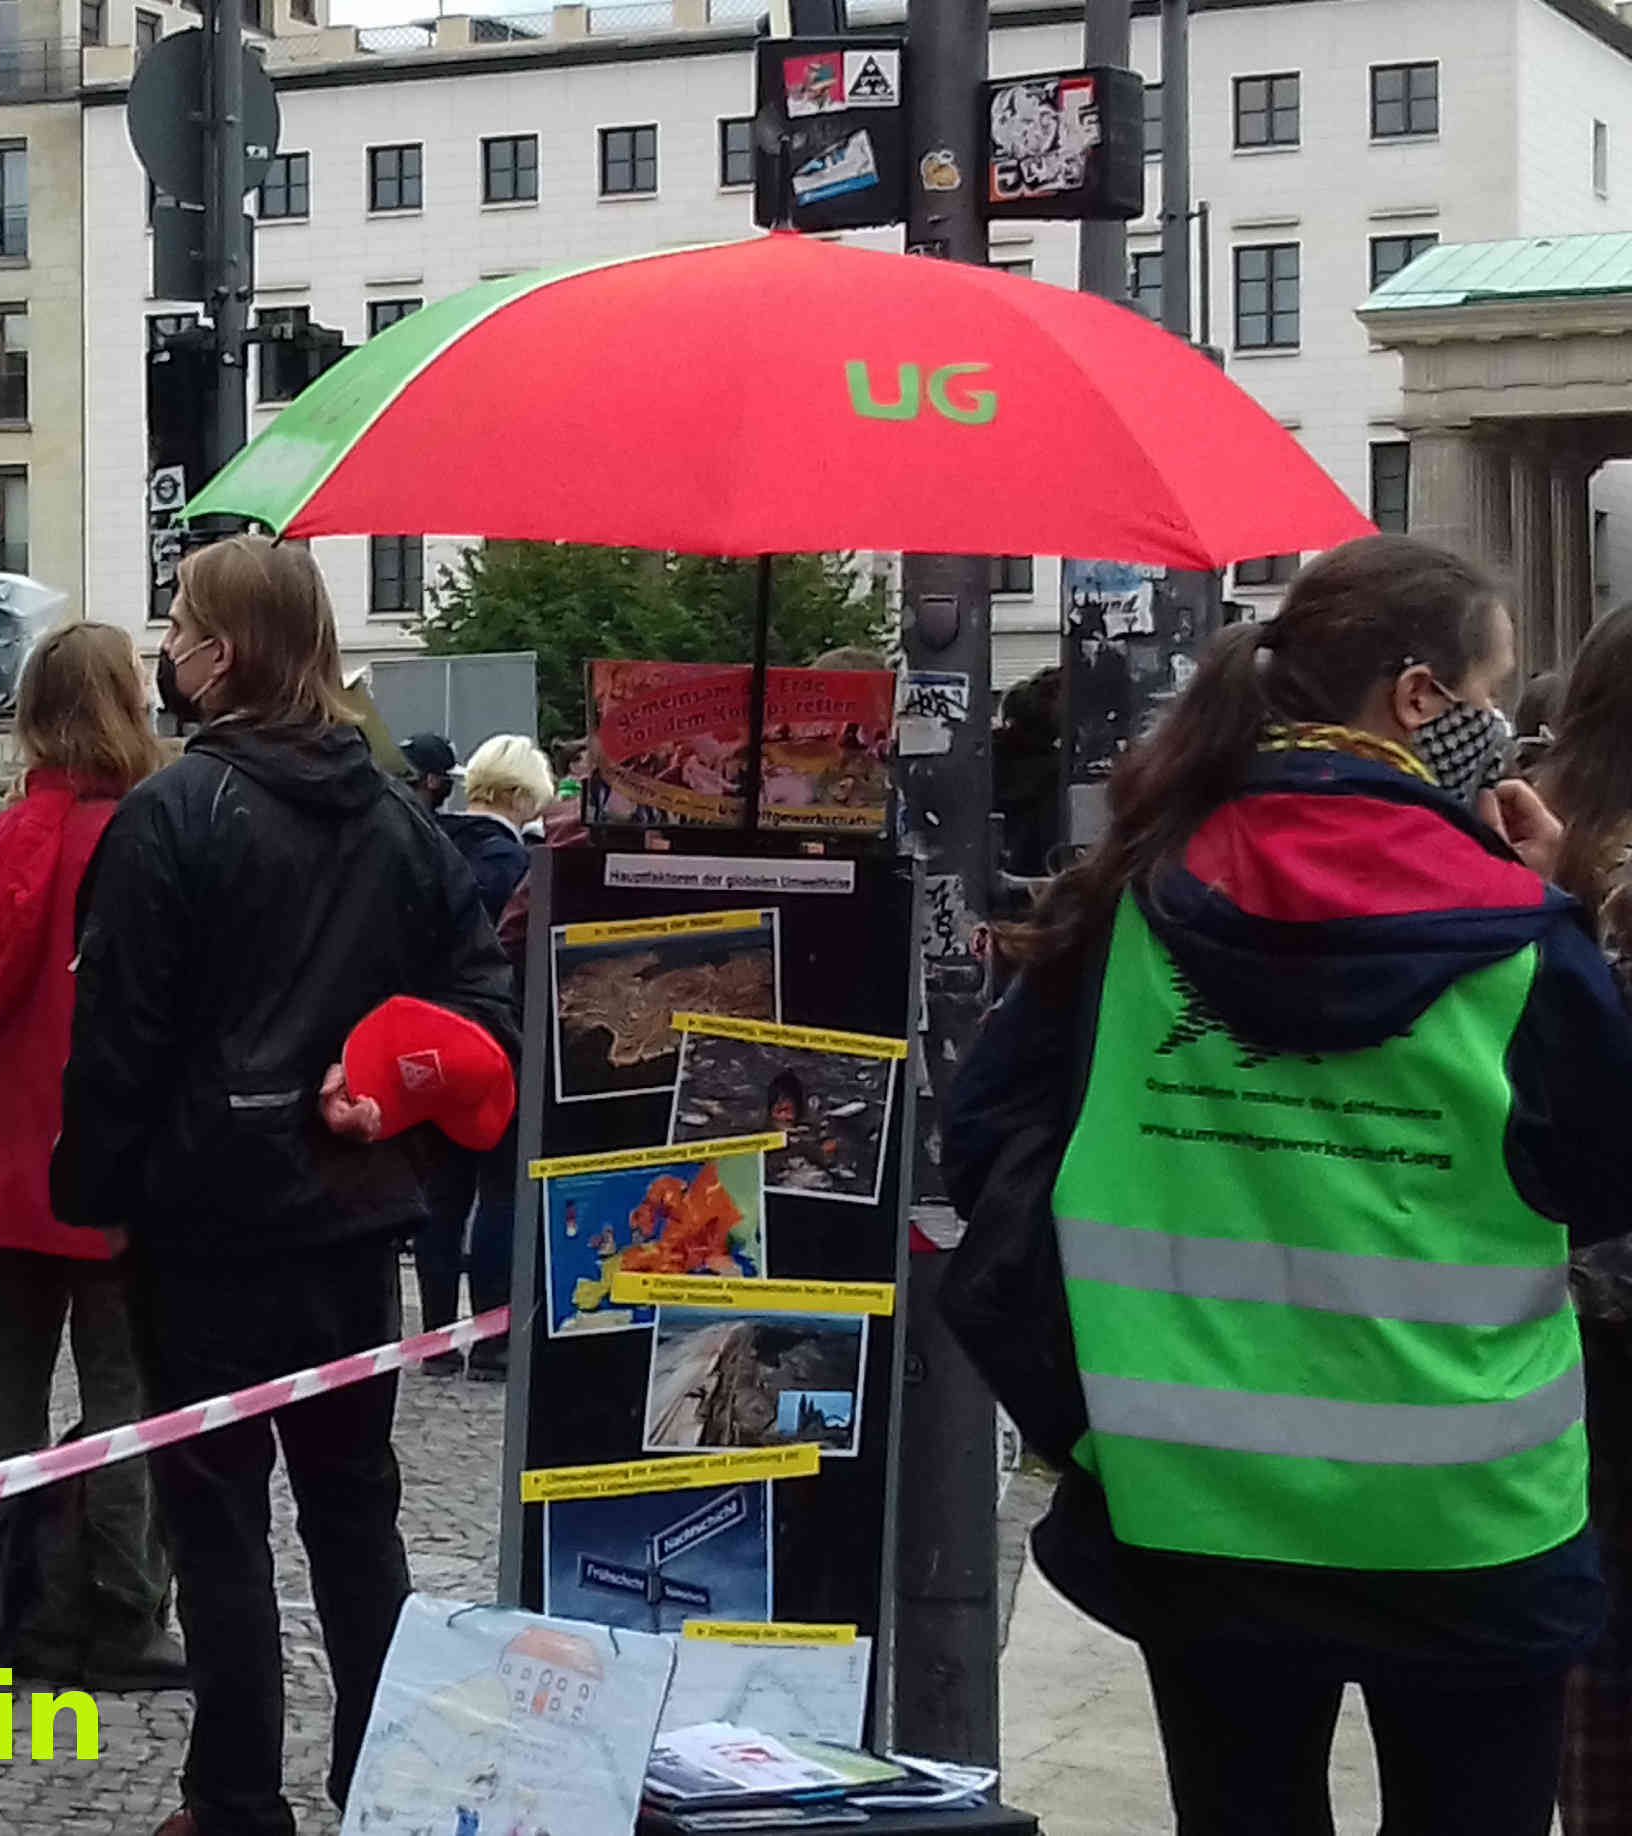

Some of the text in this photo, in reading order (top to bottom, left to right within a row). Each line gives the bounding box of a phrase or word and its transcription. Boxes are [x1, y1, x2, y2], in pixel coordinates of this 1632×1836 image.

[845, 361, 997, 425] UG
[610, 871, 699, 887] Hauptfaktoren
[703, 874, 723, 886] der
[726, 874, 778, 889] globalen
